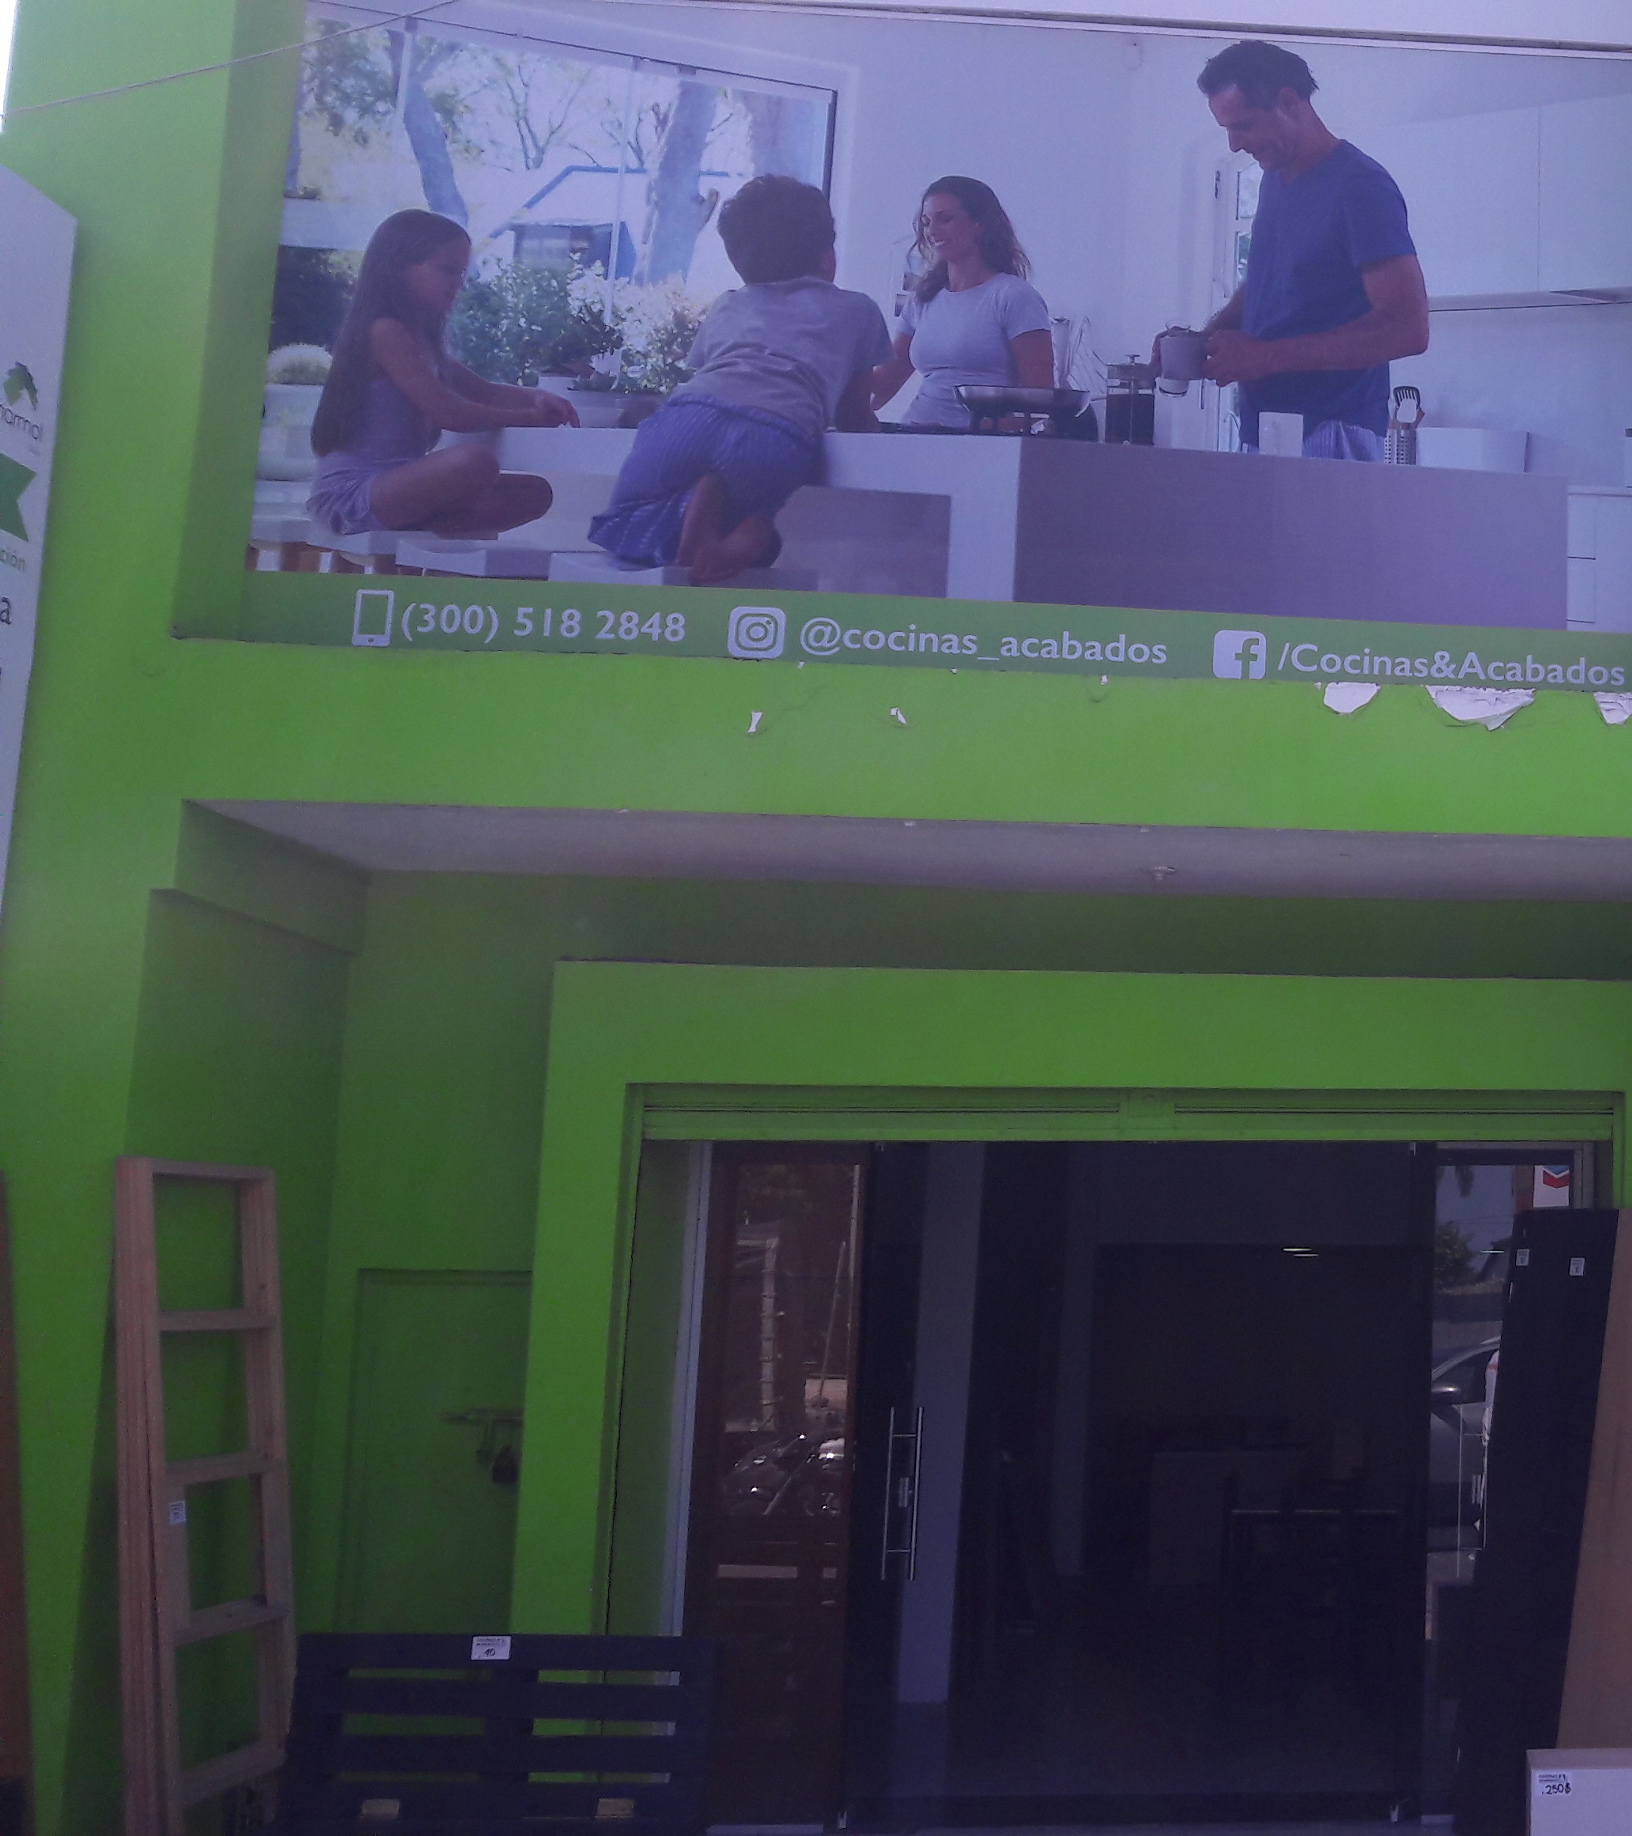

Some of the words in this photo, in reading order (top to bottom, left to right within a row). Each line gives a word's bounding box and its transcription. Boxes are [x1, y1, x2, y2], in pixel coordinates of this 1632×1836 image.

[401, 602, 499, 643] (300)
[513, 606, 582, 639] 518
[595, 609, 687, 643] 2848
[799, 616, 1168, 665] @cocinas_acabados
[1277, 641, 1626, 687] /Cocinas&Acabados
